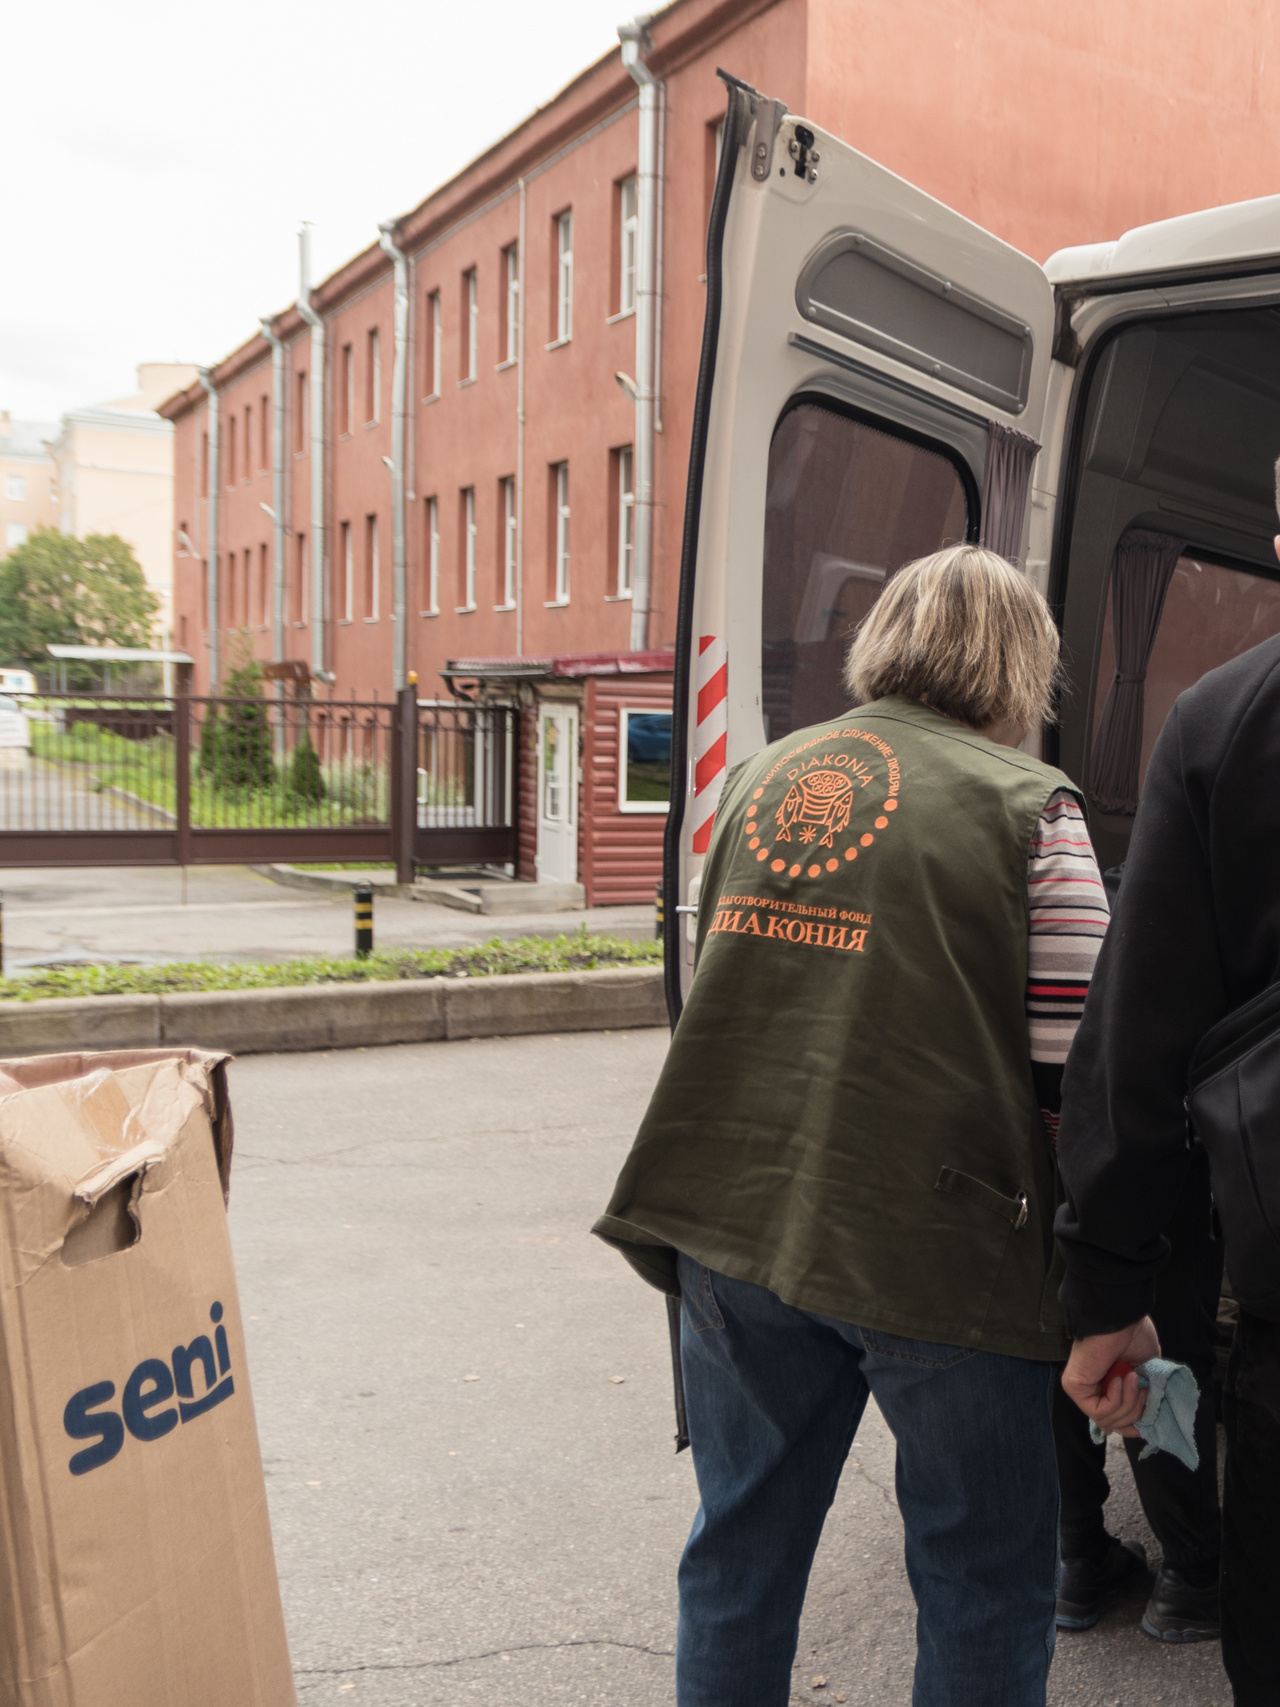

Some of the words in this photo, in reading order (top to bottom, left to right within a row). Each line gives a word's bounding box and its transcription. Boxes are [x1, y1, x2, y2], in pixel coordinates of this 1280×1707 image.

[787, 754, 874, 788] DIAKONIA
[841, 729, 894, 758] СЛУЖЕНИЕ
[886, 757, 900, 797] ЛЮДЯМ
[706, 910, 869, 952] ДИАКОНИЯ
[839, 909, 872, 925] ФОНД
[63, 1301, 235, 1476] seni
